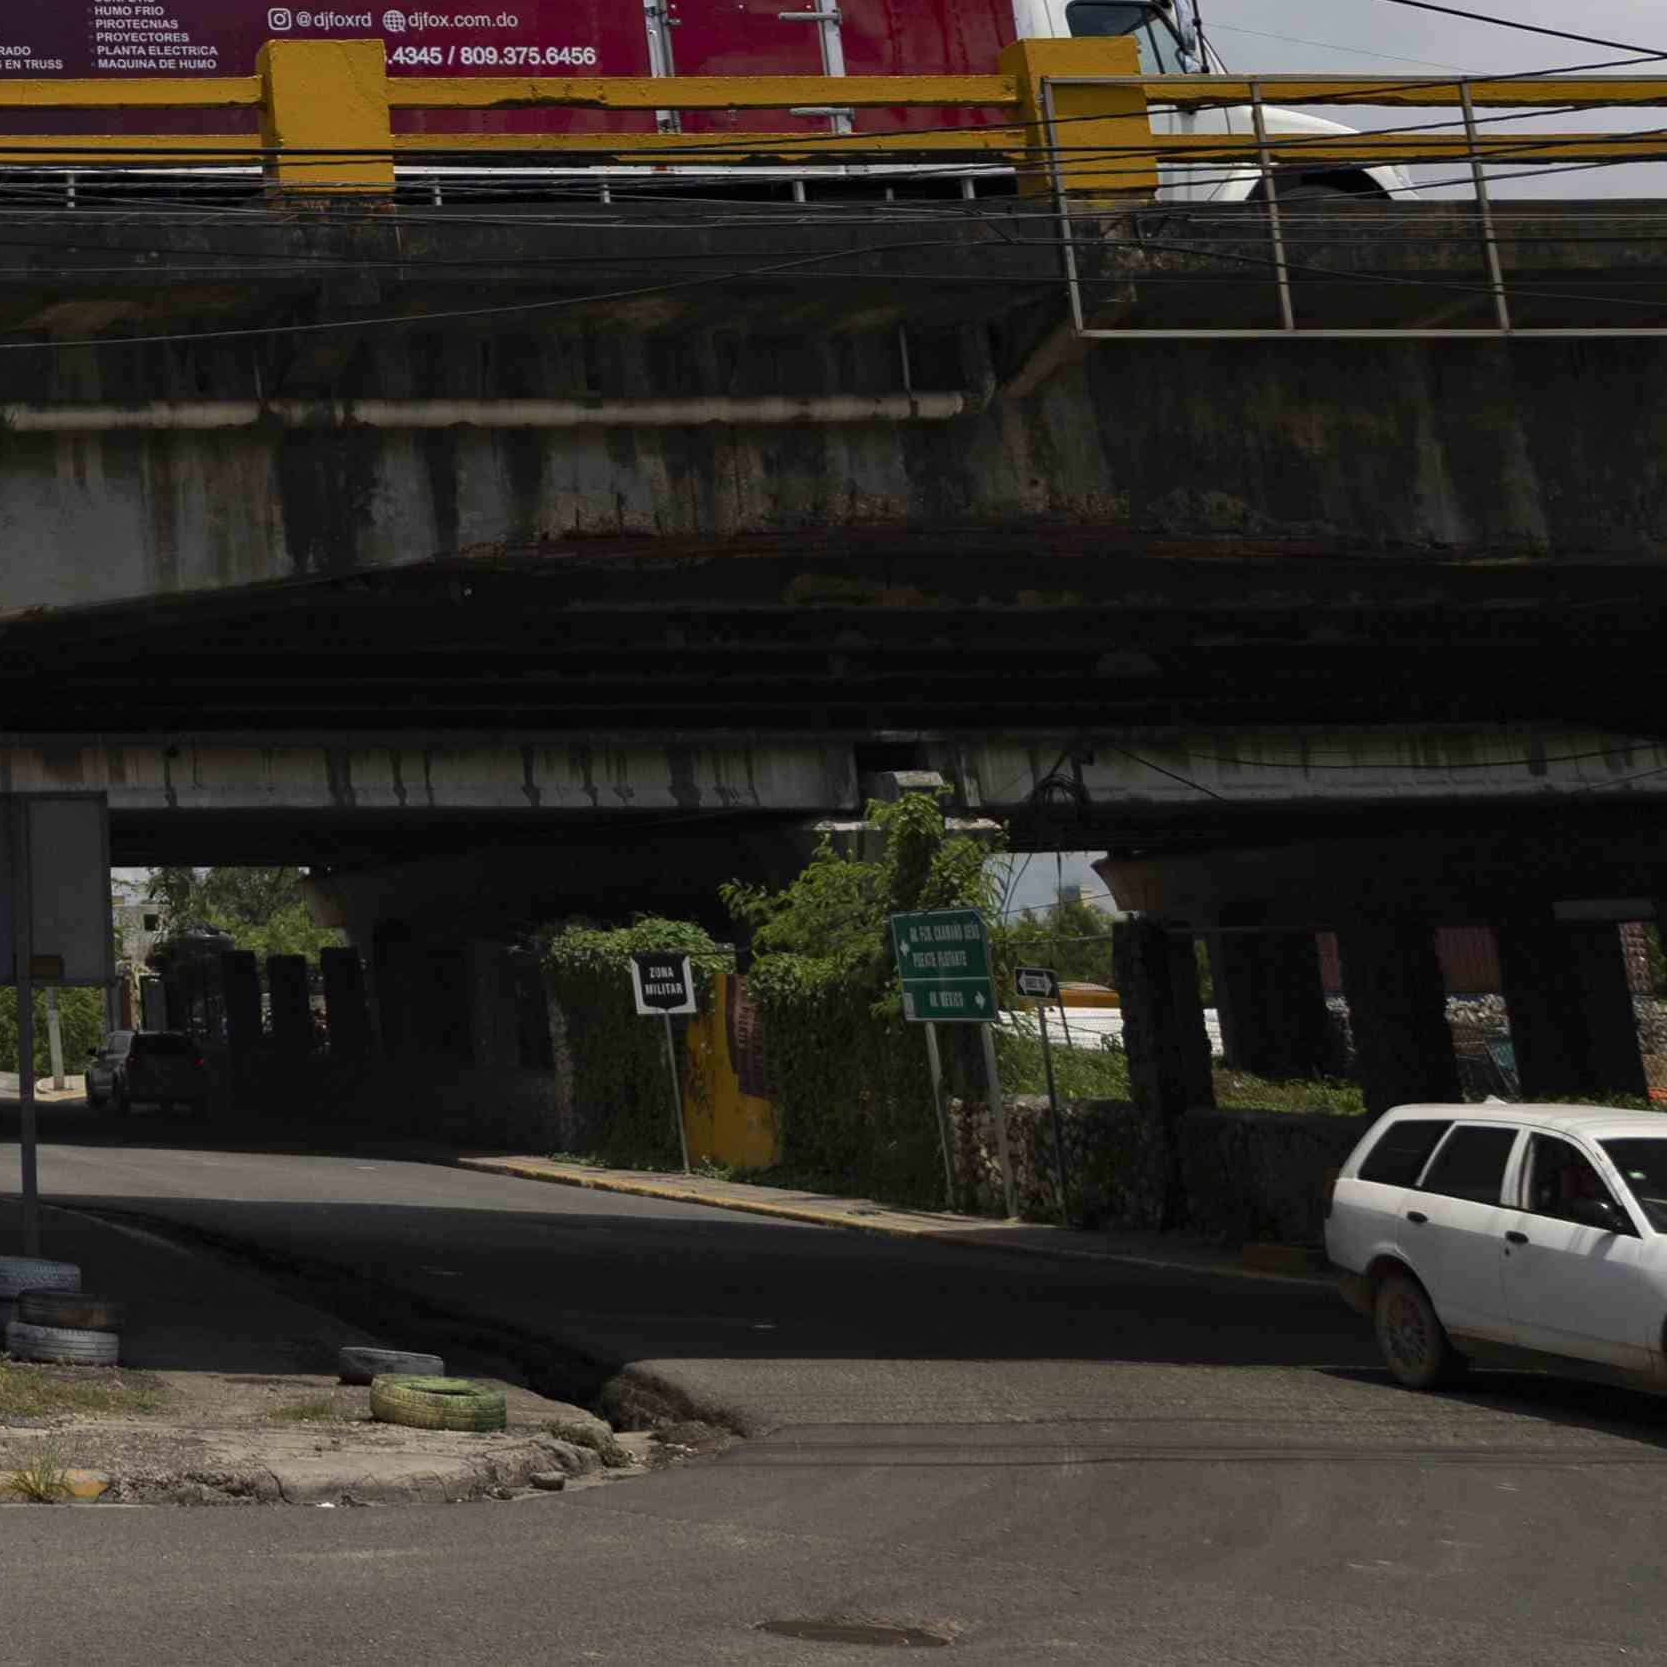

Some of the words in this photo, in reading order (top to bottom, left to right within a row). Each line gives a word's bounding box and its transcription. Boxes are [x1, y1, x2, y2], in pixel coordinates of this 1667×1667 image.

[94, 6, 131, 16] HUMO
[135, 6, 164, 16] FRIO
[95, 19, 179, 29] PIROTECNIAS
[296, 11, 372, 30] @djfoxrd
[408, 12, 519, 30] djfox.com.do
[96, 33, 189, 42] PROYECTORES
[97, 46, 146, 56] PLANTA
[149, 46, 218, 56] ELECTRICA
[460, 47, 596, 65] 809.375.6456
[5, 59, 21, 69] EN
[24, 59, 64, 70] TRUSS
[98, 59, 156, 70] MAQUINA
[159, 59, 176, 69] DE
[179, 59, 217, 69] HUMO
[649, 966, 675, 979] ZONA
[644, 982, 683, 995] MILITAR
